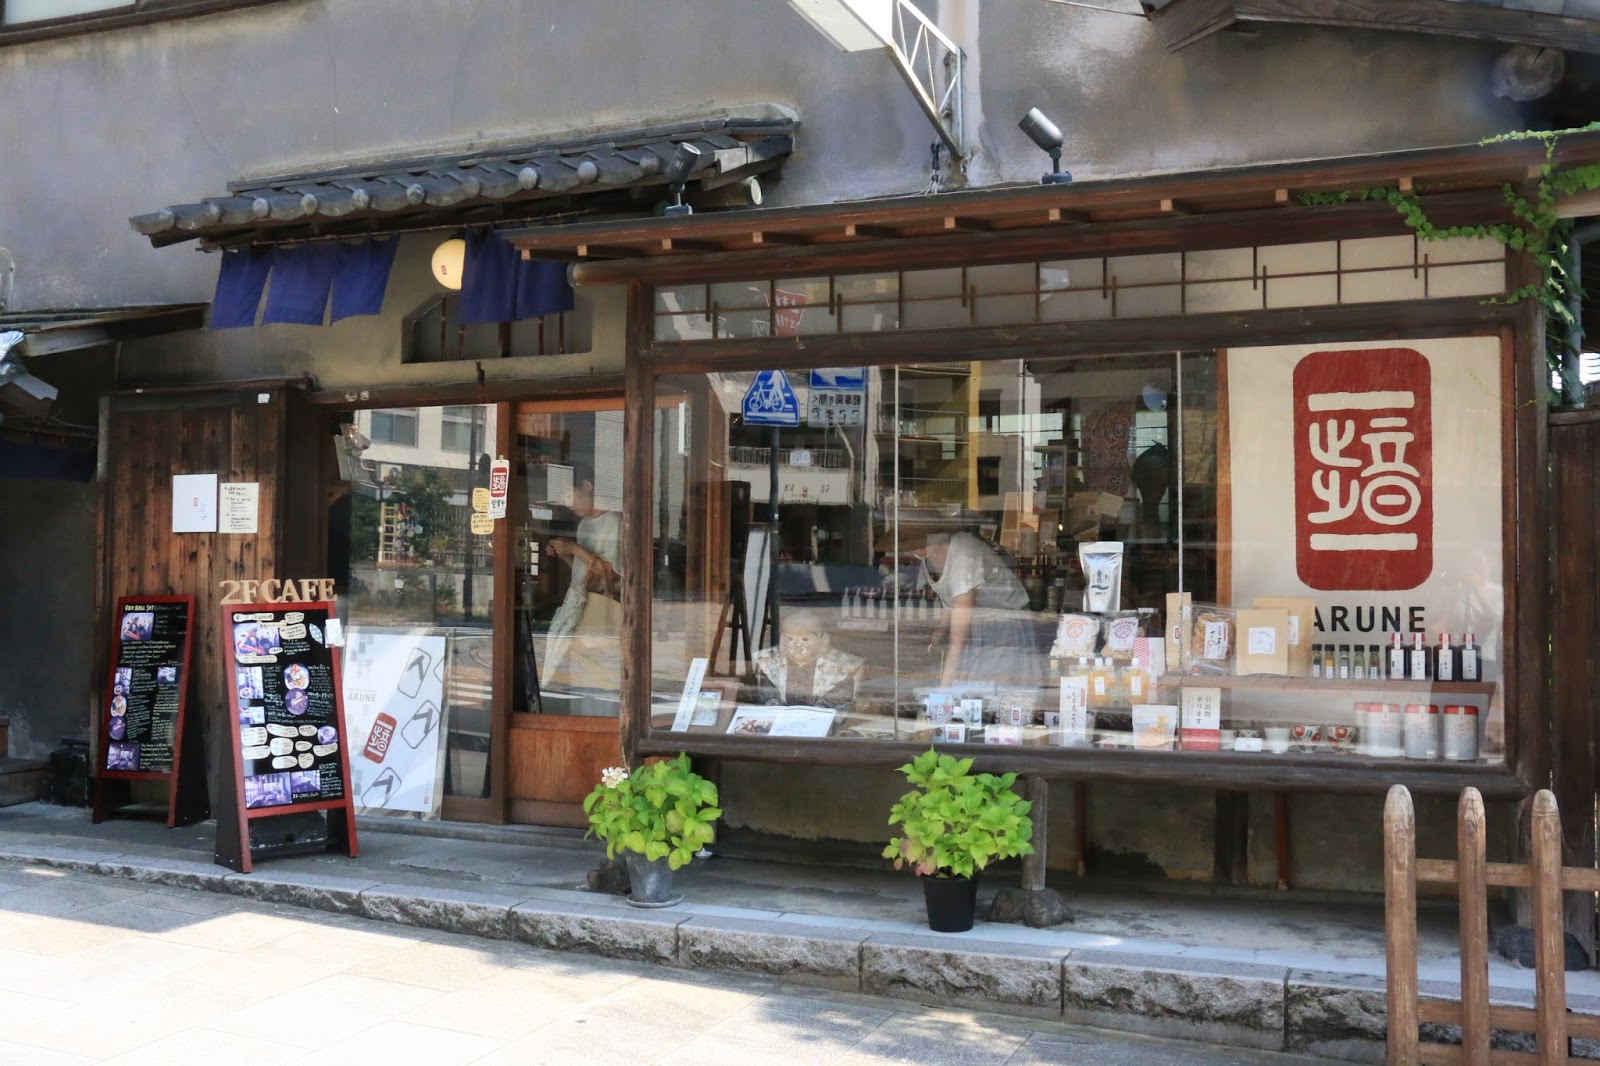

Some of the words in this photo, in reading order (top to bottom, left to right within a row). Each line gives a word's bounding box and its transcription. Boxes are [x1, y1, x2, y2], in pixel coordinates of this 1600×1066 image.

[347, 693, 376, 703] ARUNE
[1204, 696, 1212, 718] 引出物
[1195, 695, 1203, 724] 承ります
